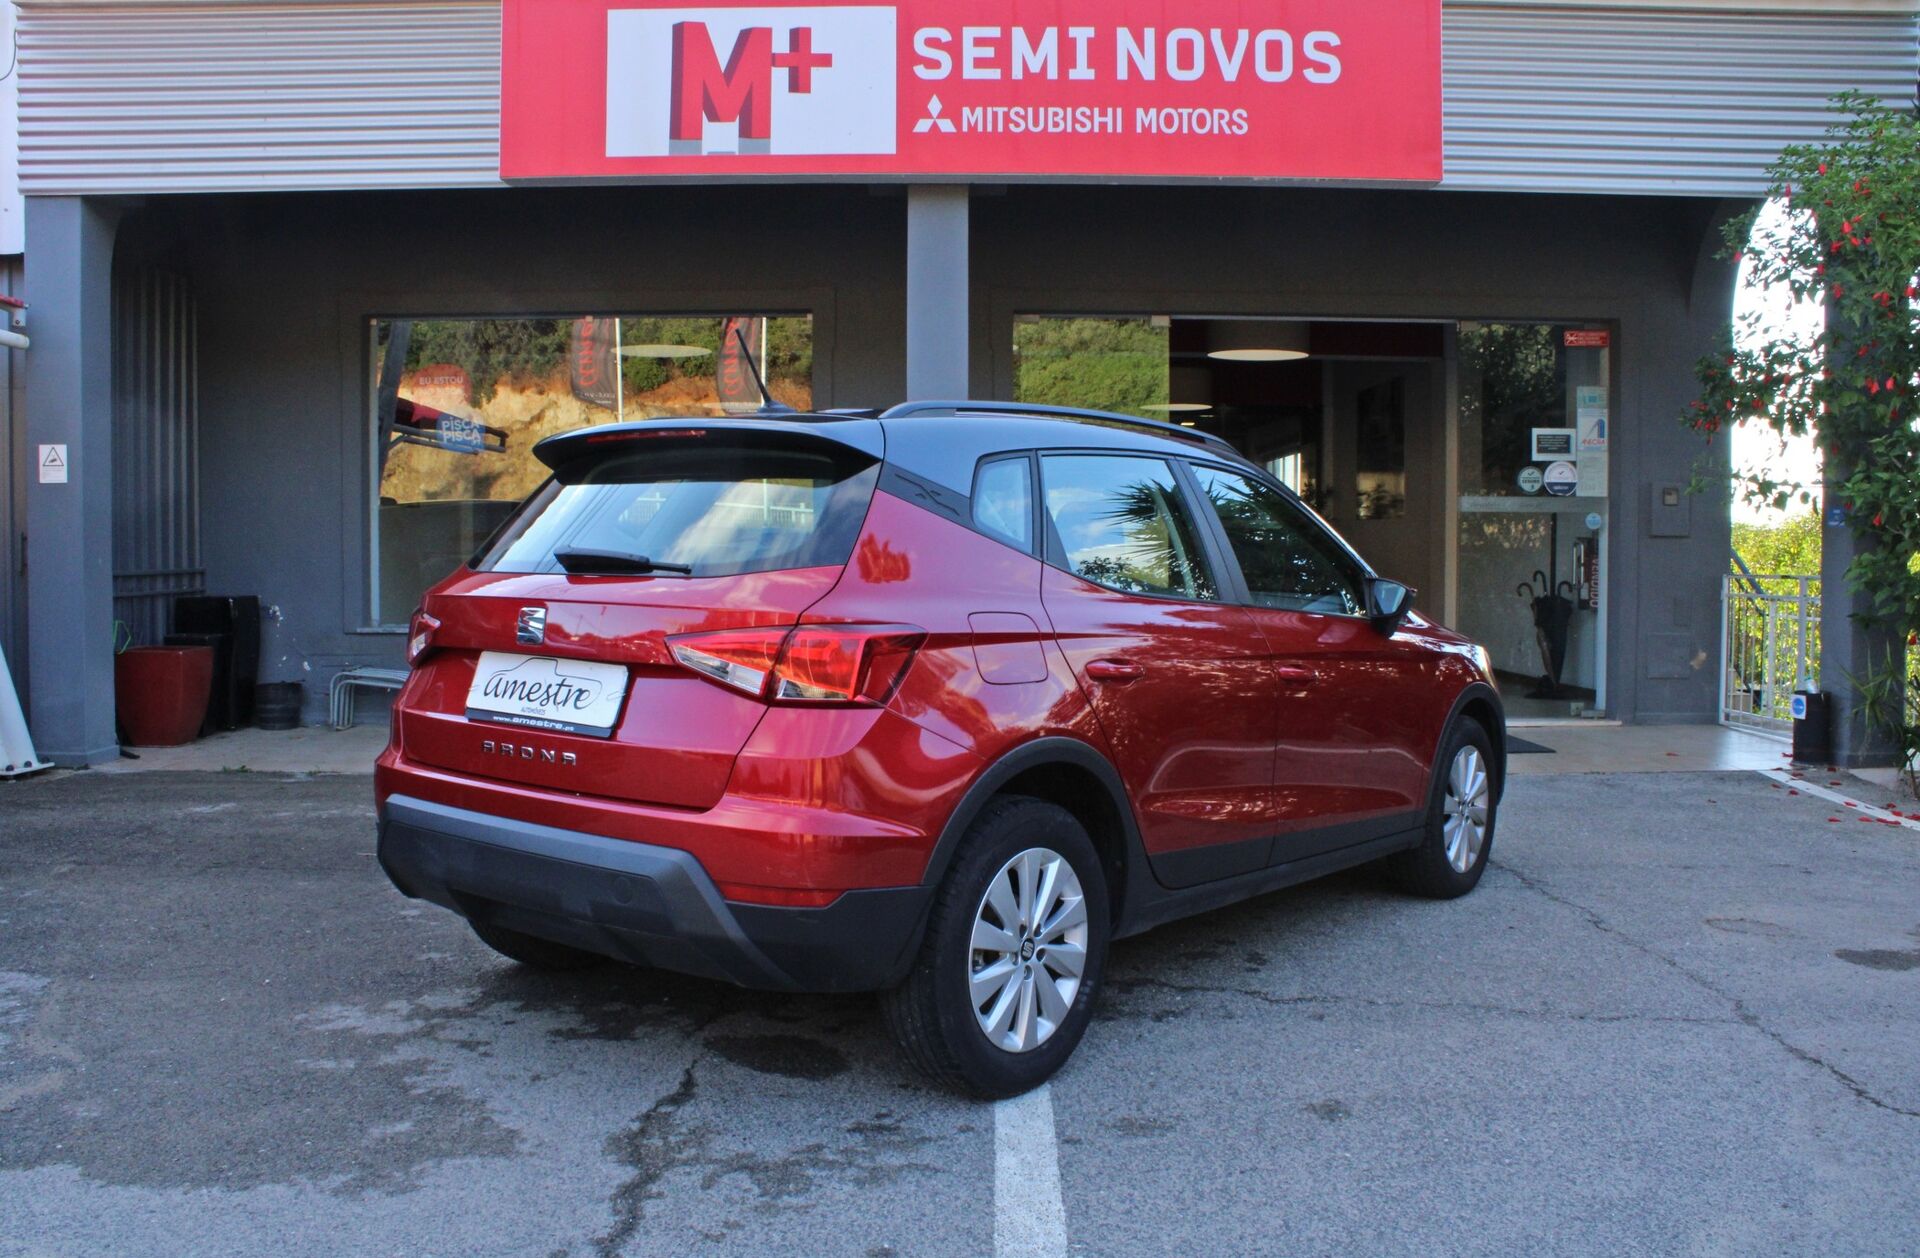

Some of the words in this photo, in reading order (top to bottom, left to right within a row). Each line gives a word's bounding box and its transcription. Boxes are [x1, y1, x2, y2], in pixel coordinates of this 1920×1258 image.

[912, 26, 1096, 81] SEMI
[1116, 26, 1342, 84] NOVOS
[962, 106, 1123, 133] MITSUBISHI
[1136, 108, 1249, 135] MOTORS
[434, 376, 464, 385] ESTOU
[484, 674, 591, 710] amestre
[483, 740, 577, 766] ARONA
